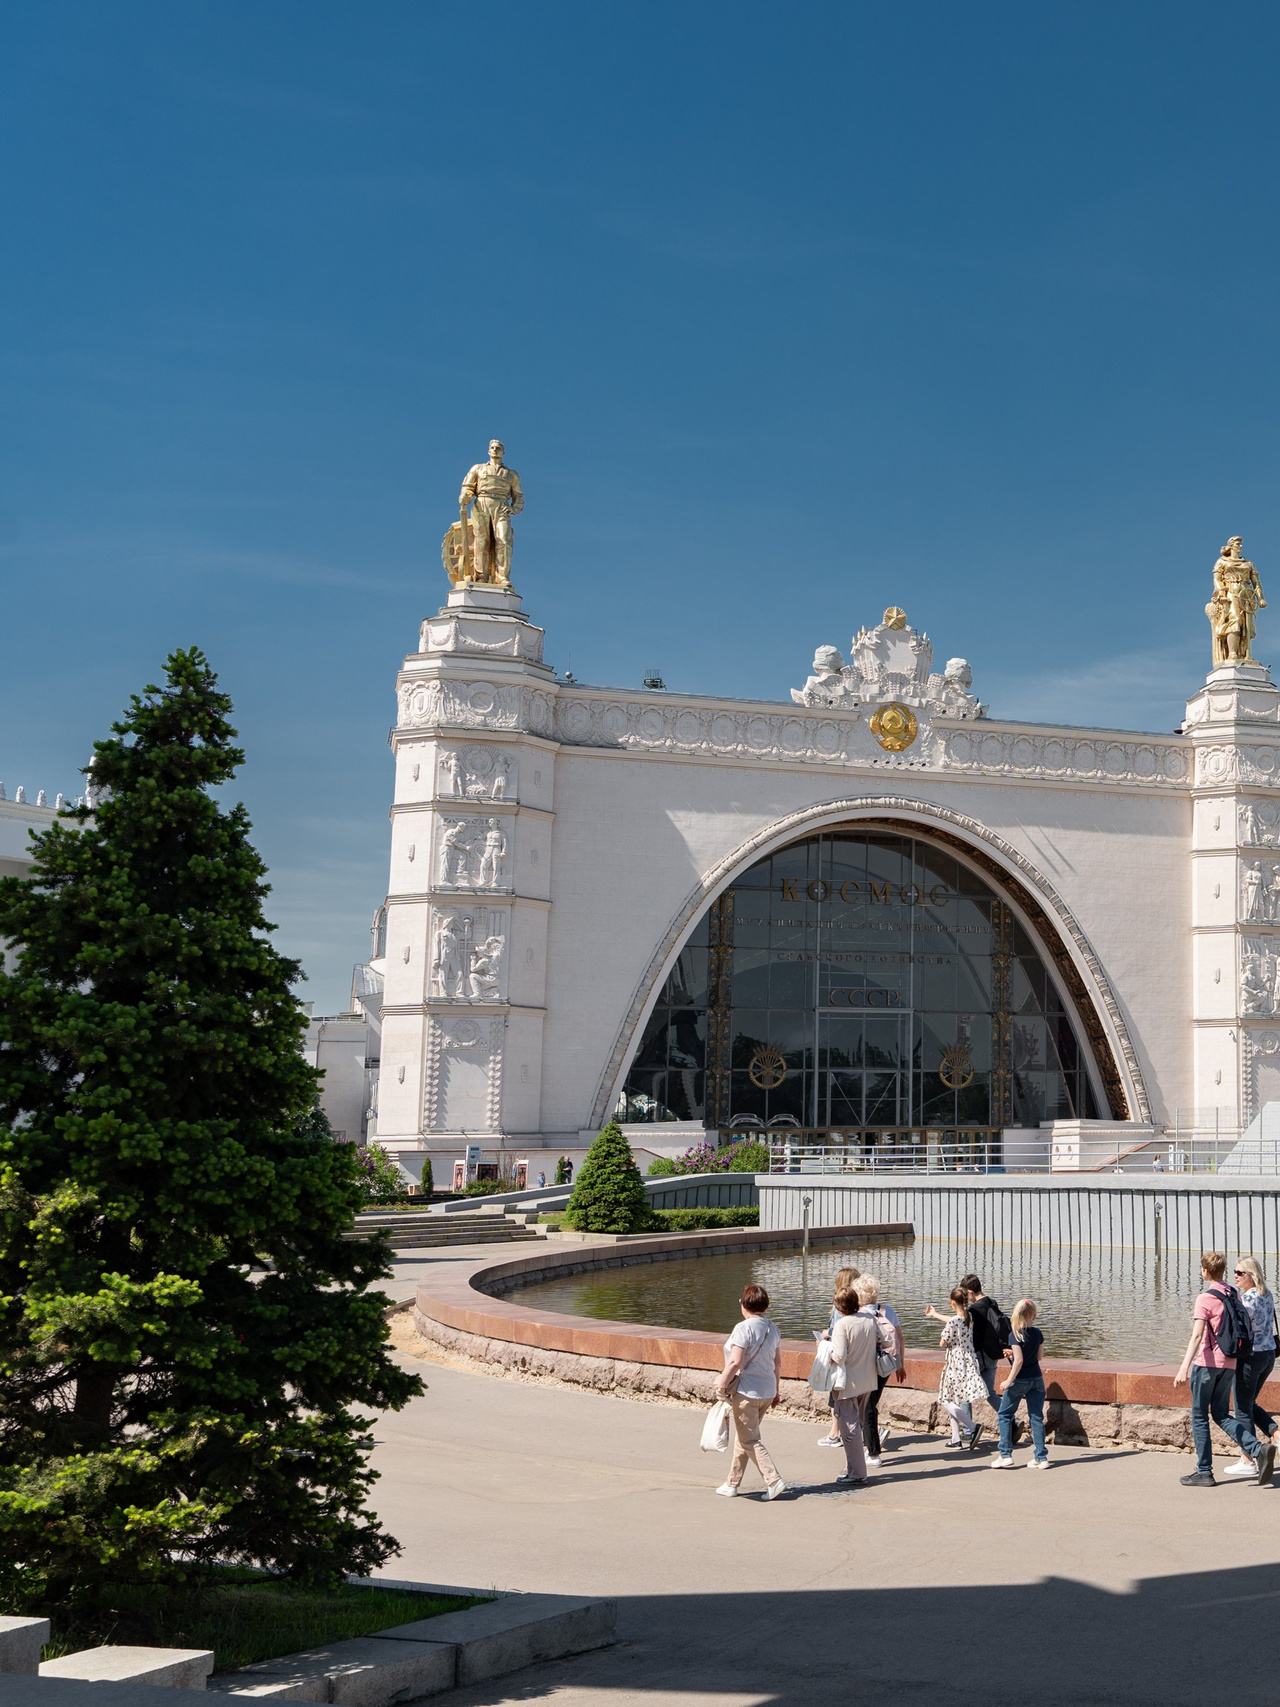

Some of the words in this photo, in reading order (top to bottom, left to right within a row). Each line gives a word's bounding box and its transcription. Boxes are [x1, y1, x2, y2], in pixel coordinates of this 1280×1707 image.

[780, 877, 950, 907] КОСМОС
[736, 917, 843, 929] МЕХАНИЗАЦИЯ
[776, 952, 862, 963] СЕЛЬСКОГО
[829, 988, 901, 1008] СССР
